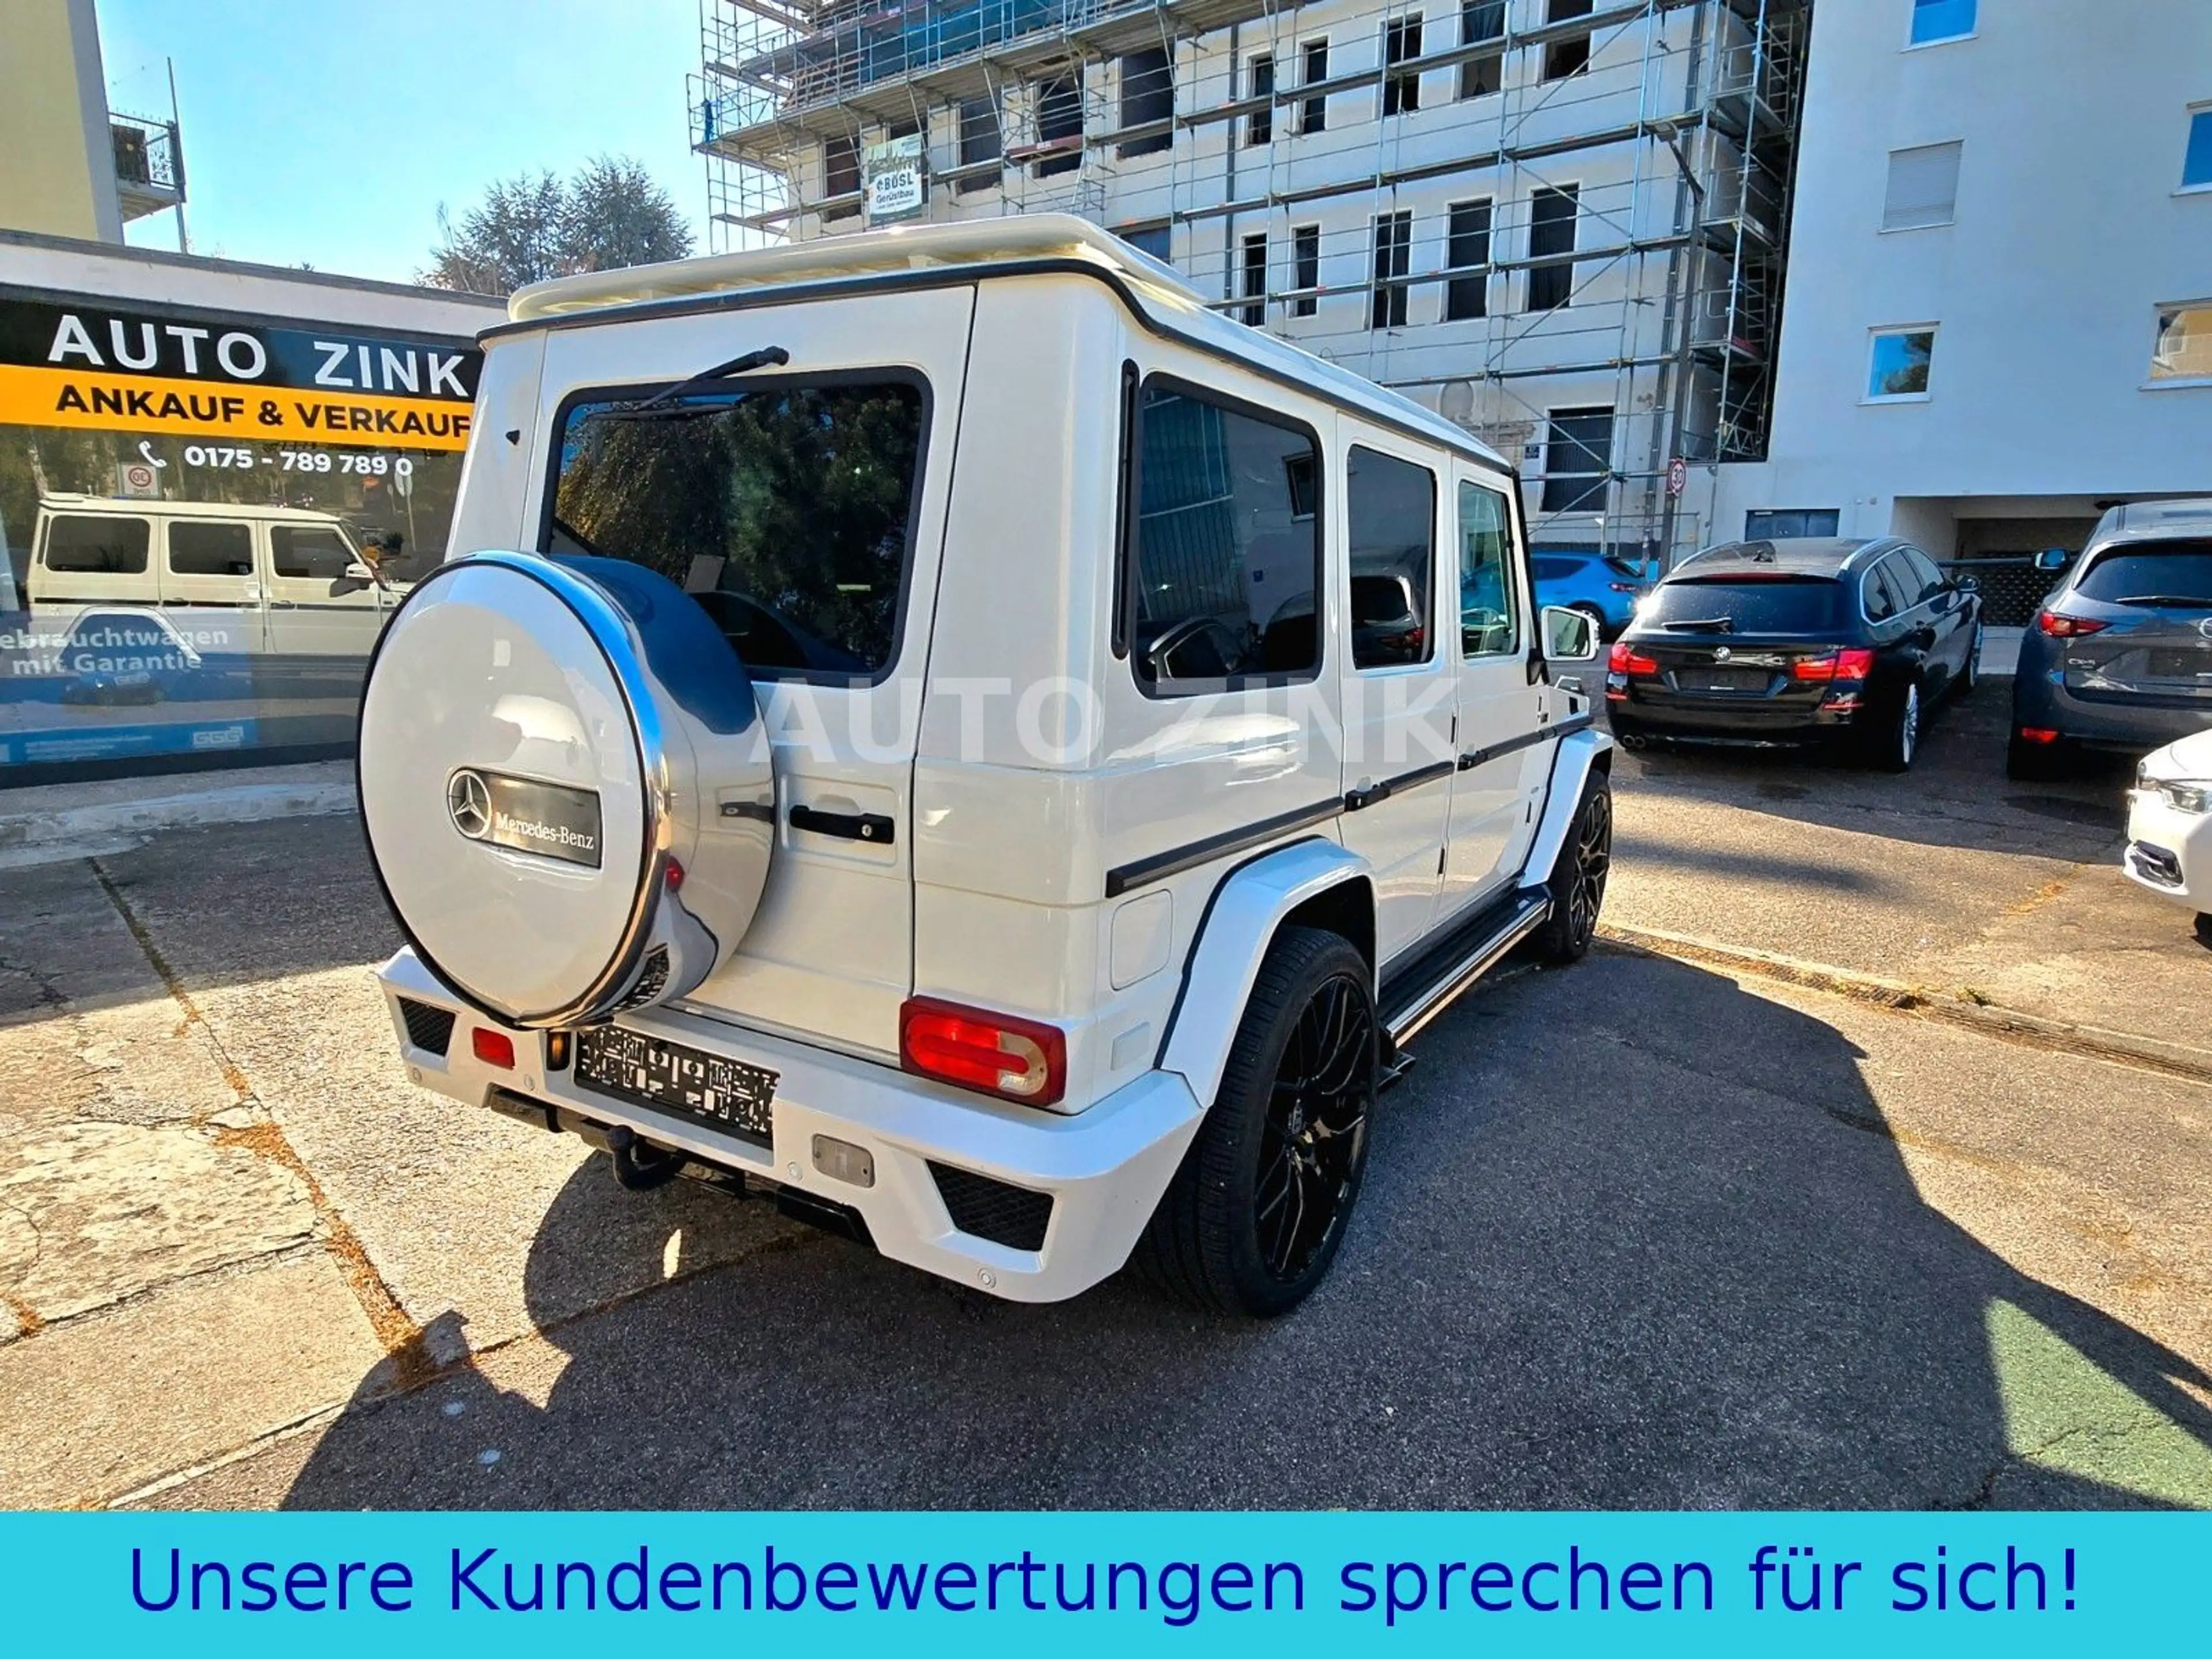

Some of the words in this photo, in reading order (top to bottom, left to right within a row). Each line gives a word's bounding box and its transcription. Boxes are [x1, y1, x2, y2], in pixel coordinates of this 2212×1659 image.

[47, 315, 267, 380] AUTO
[314, 341, 469, 397] ZINK
[55, 384, 244, 423] ANKAUF
[258, 401, 283, 426] &
[294, 402, 471, 438] VERKAUF
[184, 446, 254, 469] 0175
[279, 452, 332, 473] 789
[338, 454, 388, 475] 789
[395, 457, 413, 476] 0
[1673, 468, 1683, 484] 30
[13, 654, 66, 675] mit
[74, 652, 202, 672] Garantie
[495, 811, 594, 850] Mercedes-Benz
